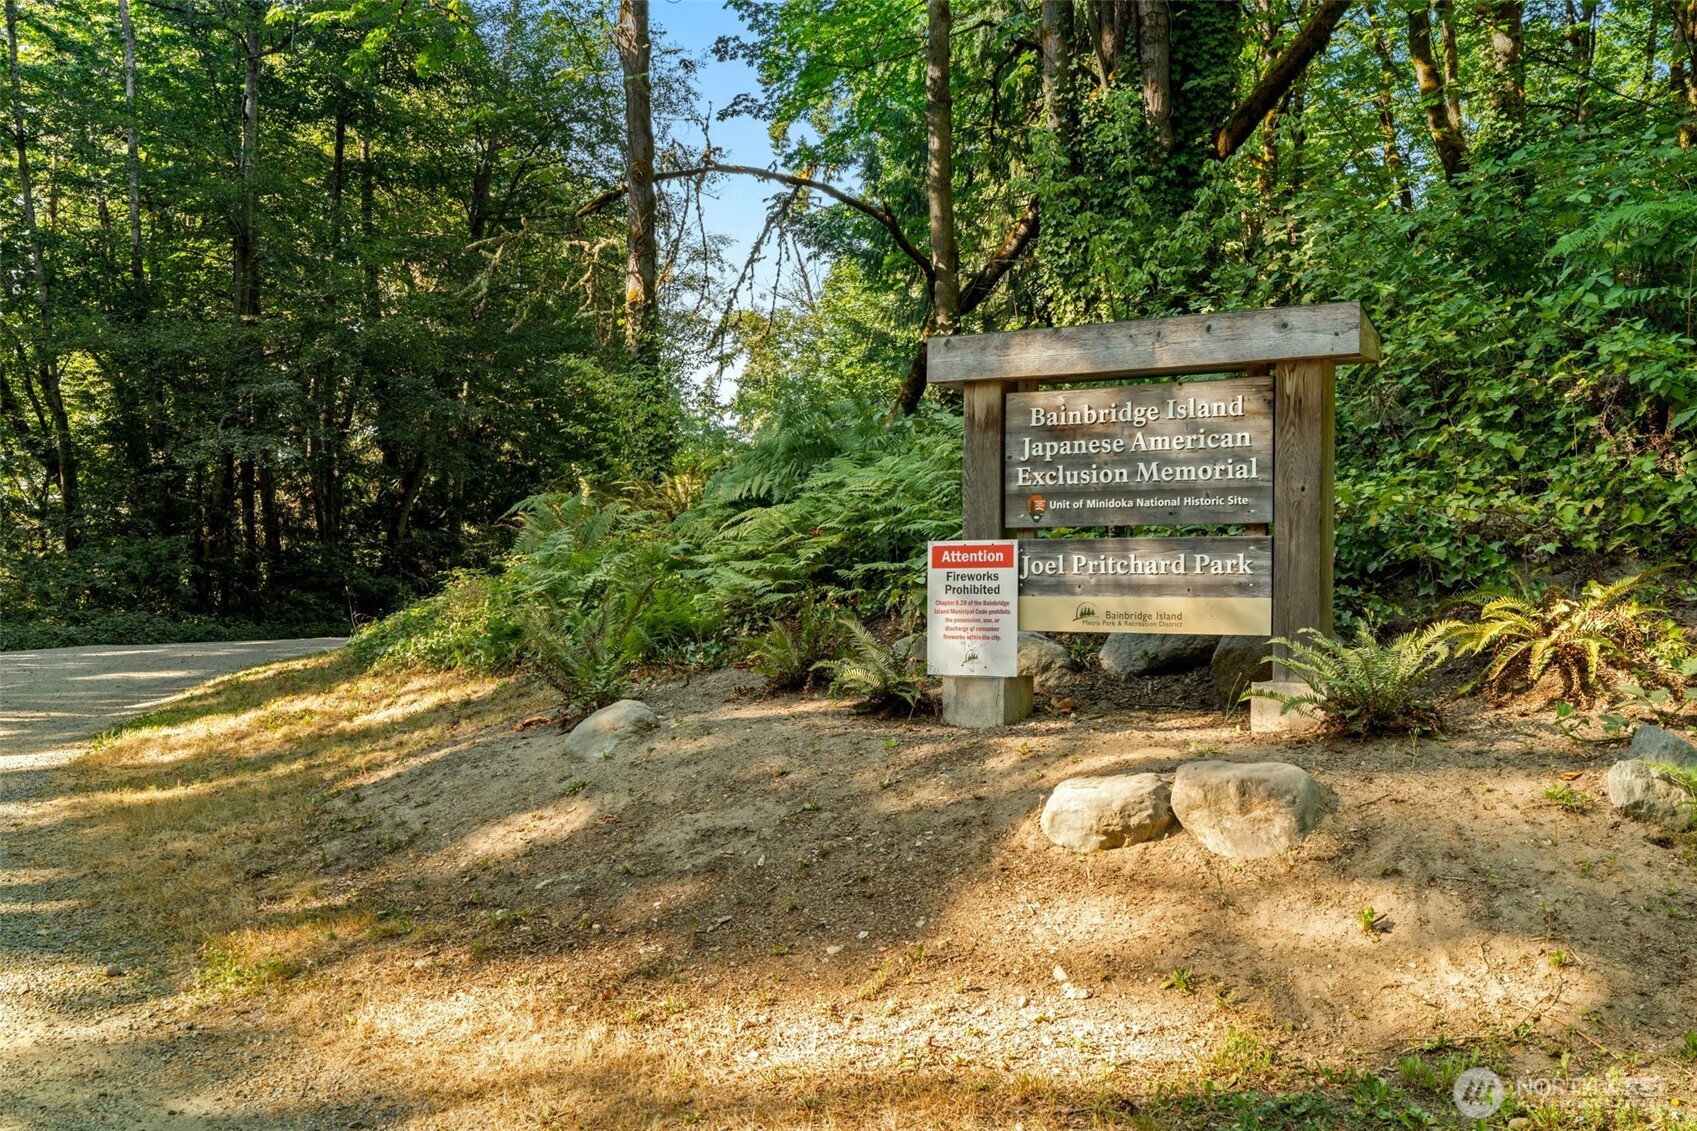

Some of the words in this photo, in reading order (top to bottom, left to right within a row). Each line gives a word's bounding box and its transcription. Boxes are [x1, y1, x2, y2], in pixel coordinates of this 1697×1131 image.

[1030, 401, 1159, 427] Bainbridge
[1166, 395, 1245, 419] Island
[1020, 437, 1125, 462] Japanese
[1130, 428, 1252, 452] American
[1016, 464, 1129, 487] Exclusion
[1136, 457, 1259, 483] Memorial
[1049, 500, 1070, 510] Unit
[1072, 499, 1083, 509] of
[1086, 498, 1133, 509] Minidoka
[1137, 496, 1180, 508] National
[1183, 496, 1225, 507] Historic
[1228, 495, 1249, 505] Site
[941, 550, 1004, 563] Attention
[1020, 554, 1065, 580] Joel
[1071, 553, 1187, 575] Pritchard
[1193, 553, 1254, 575] Park
[946, 571, 1000, 581] Fireworks
[945, 584, 1000, 595] Prohibited
[1105, 610, 1153, 622] Bainbridge
[1156, 610, 1183, 621] Island
